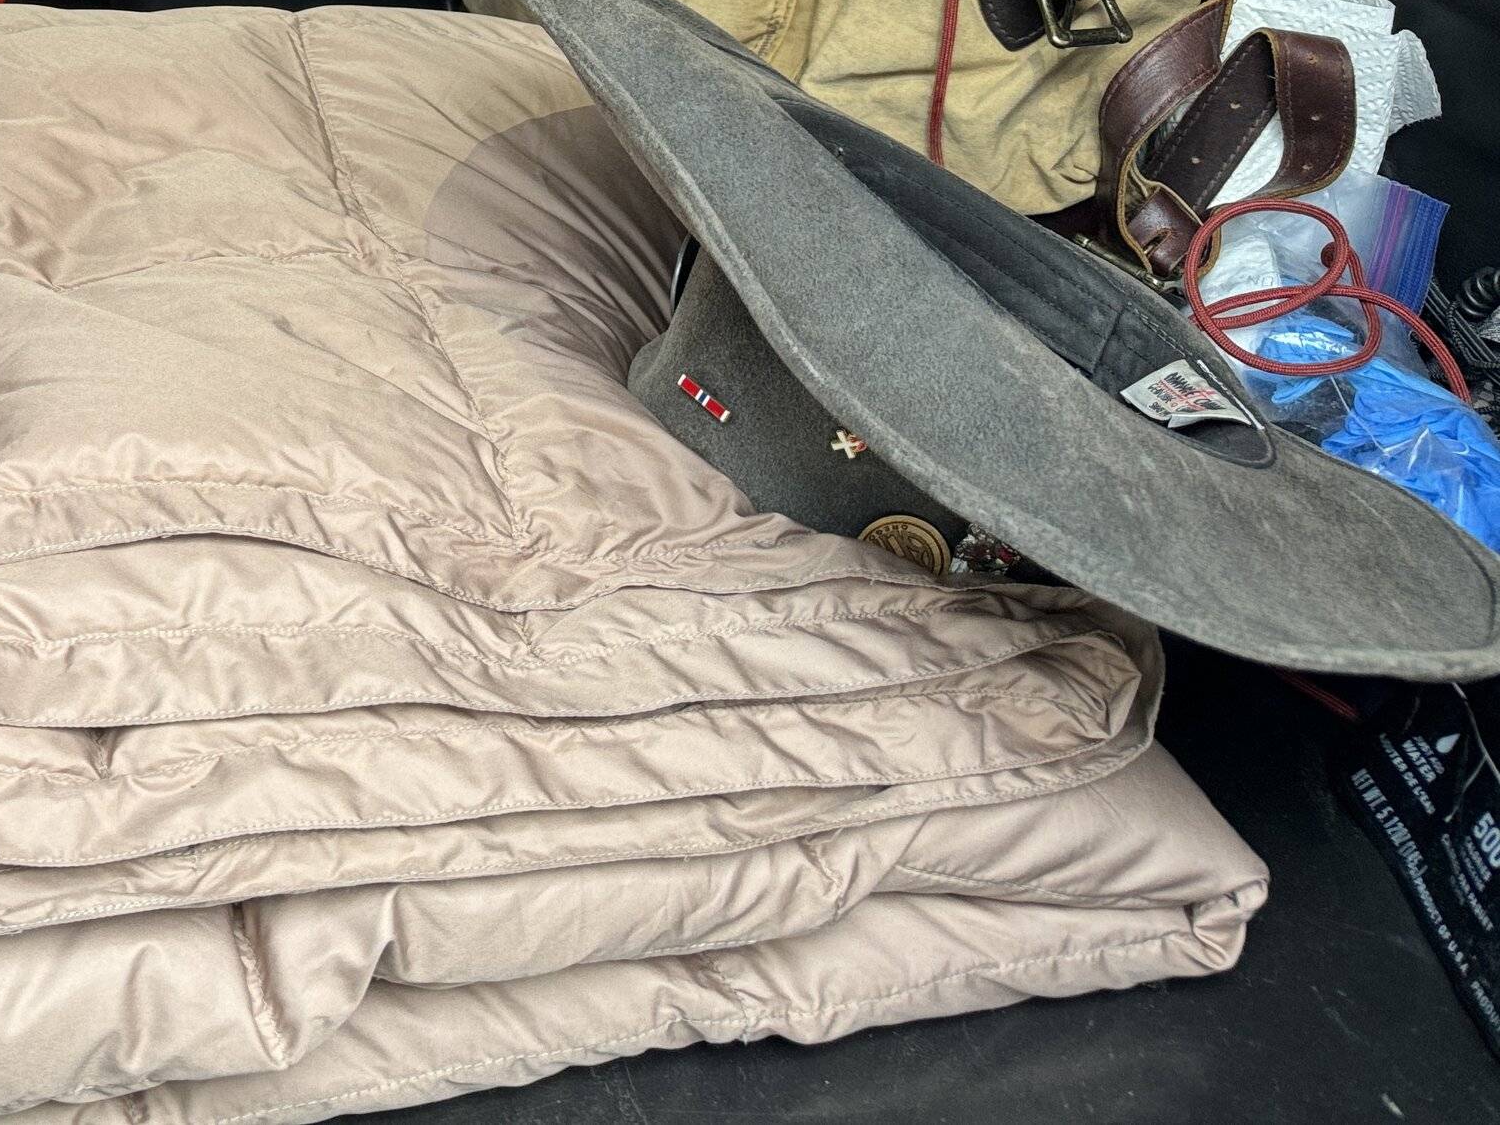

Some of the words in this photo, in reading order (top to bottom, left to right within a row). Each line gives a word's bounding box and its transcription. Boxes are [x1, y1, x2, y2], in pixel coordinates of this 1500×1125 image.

[868, 524, 909, 542] OREGO
[1402, 739, 1437, 783] WATER
[1350, 768, 1375, 790] NET
[1414, 875, 1443, 925] PRODUCT
[1438, 924, 1451, 940] OF
